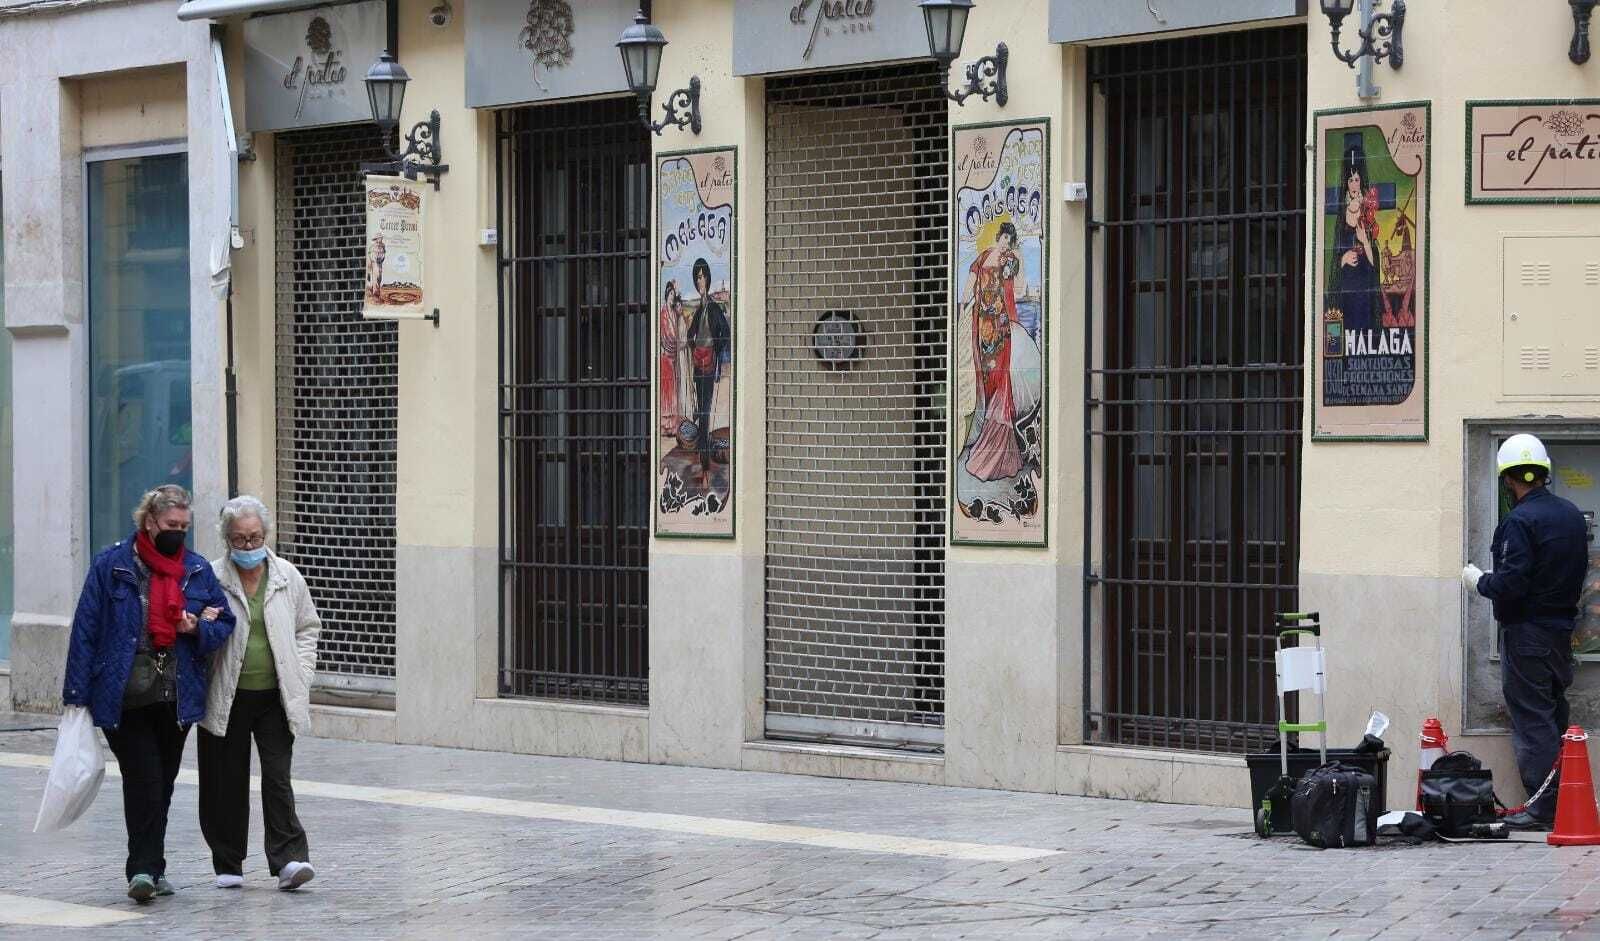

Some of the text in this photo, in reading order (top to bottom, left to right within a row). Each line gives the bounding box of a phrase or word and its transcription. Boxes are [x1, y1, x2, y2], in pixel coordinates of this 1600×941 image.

[1506, 134, 1600, 185] el pati
[1344, 327, 1413, 356] MALAGA
